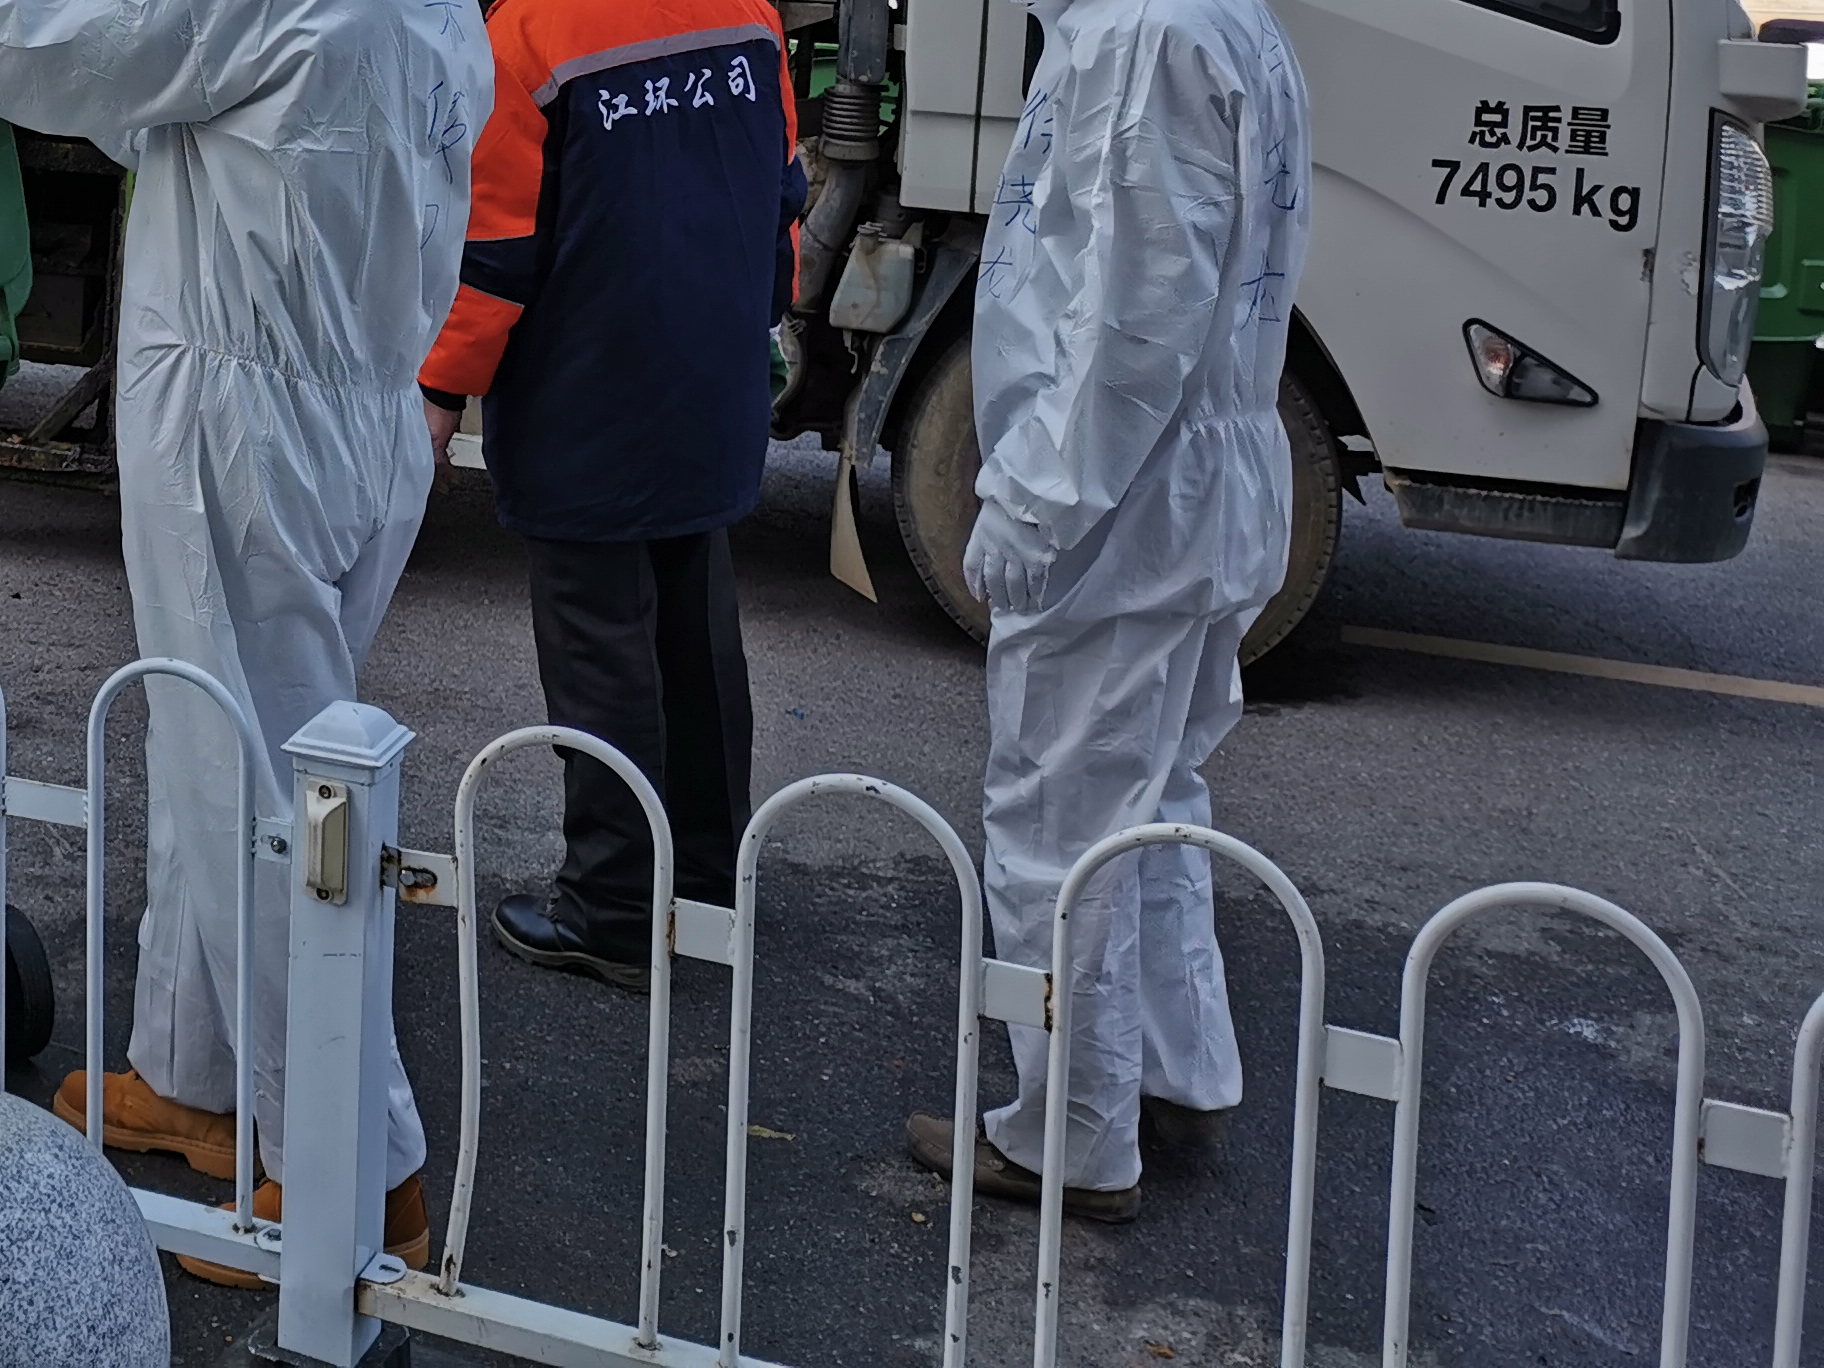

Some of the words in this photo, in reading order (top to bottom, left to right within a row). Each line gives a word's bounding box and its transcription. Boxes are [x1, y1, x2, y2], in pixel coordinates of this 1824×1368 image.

[598, 55, 756, 131] 江环公司
[1467, 99, 1612, 157] 总质量
[1431, 158, 1558, 213] 7495
[1572, 166, 1641, 233] kg
